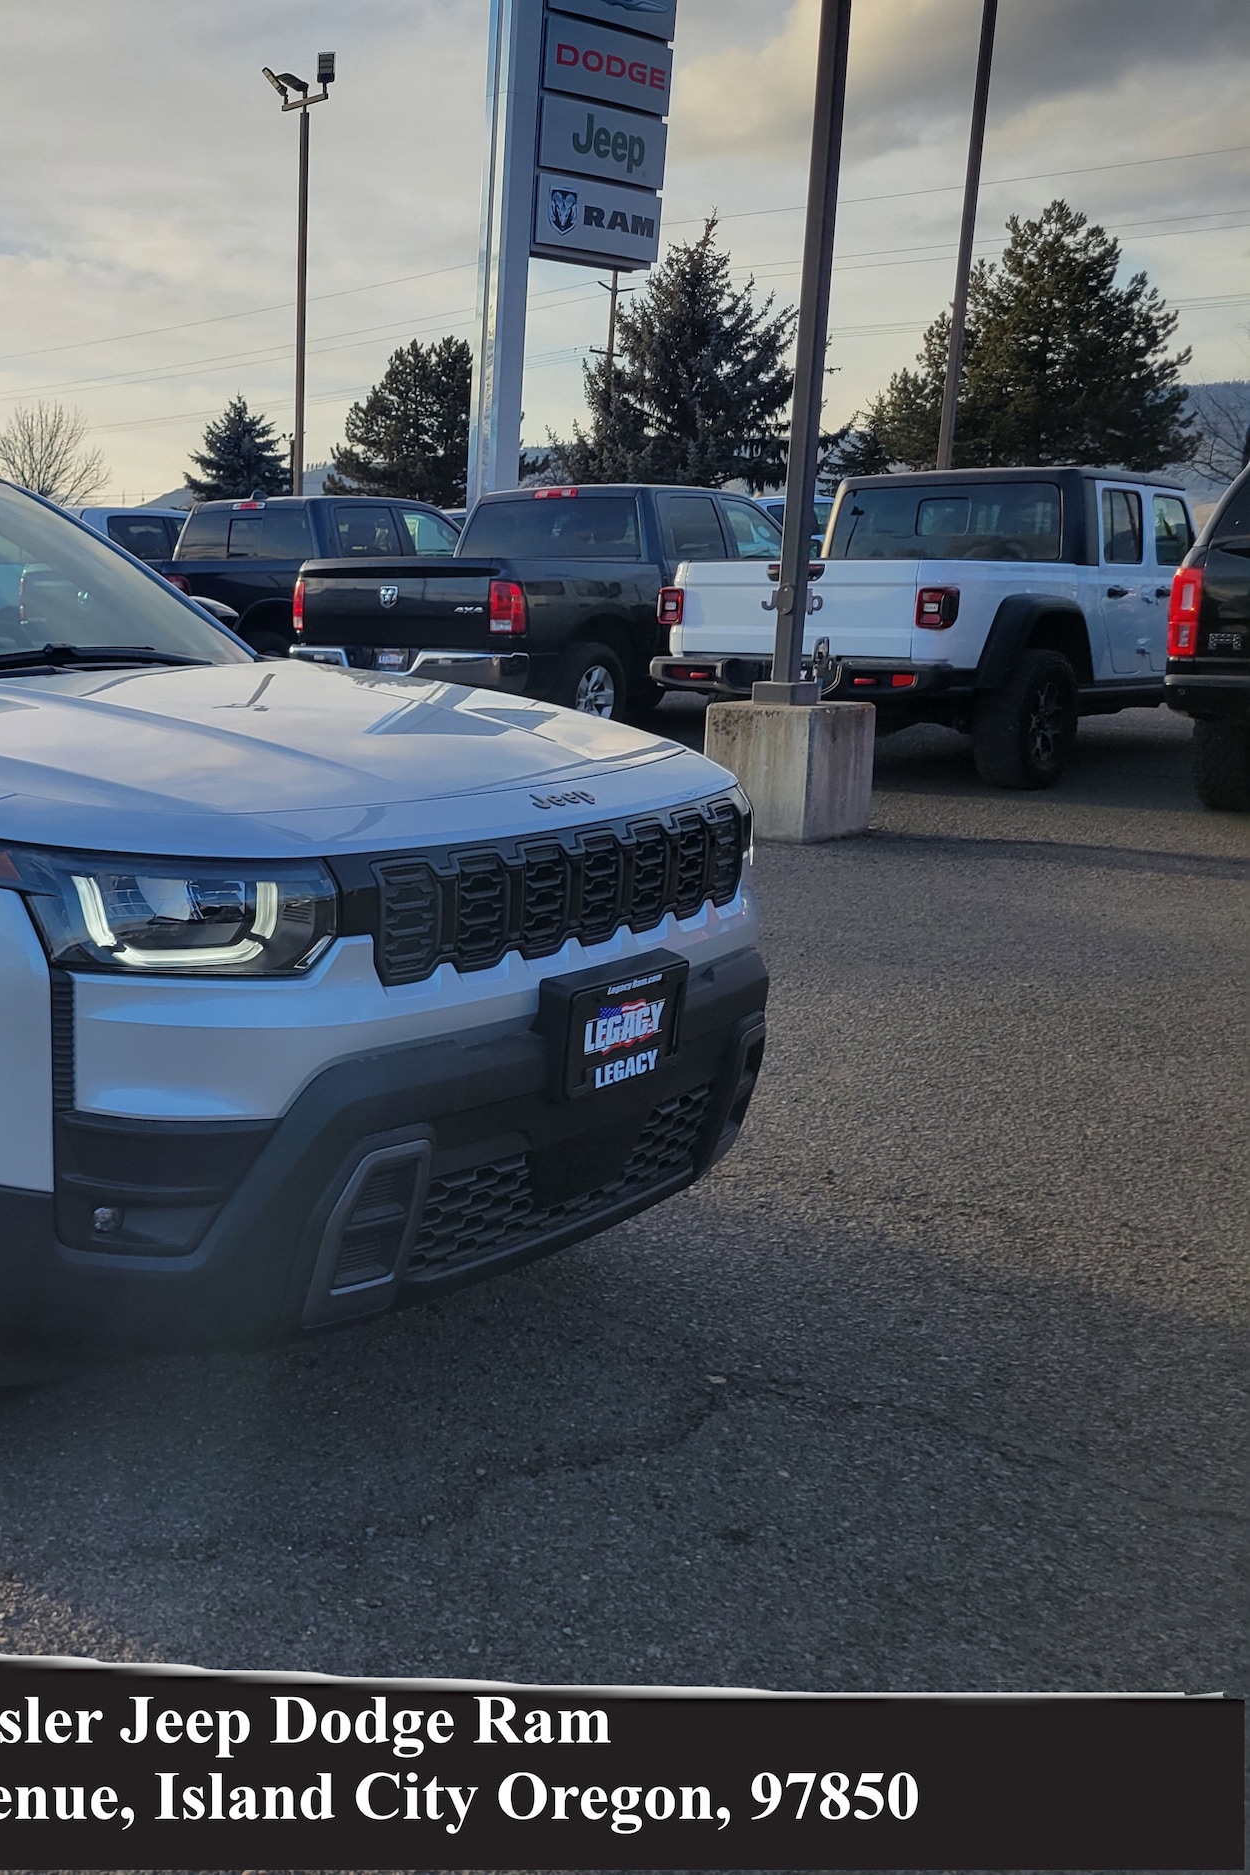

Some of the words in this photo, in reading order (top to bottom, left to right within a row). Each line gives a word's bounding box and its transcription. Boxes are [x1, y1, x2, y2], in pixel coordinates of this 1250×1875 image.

[556, 43, 666, 91] DODGE
[572, 113, 645, 174] Jeep
[583, 205, 655, 239] RAM
[761, 587, 824, 615] Jp
[529, 789, 595, 809] Jeep
[583, 1000, 666, 1054] LEGACY
[595, 1049, 659, 1089] LEGACY
